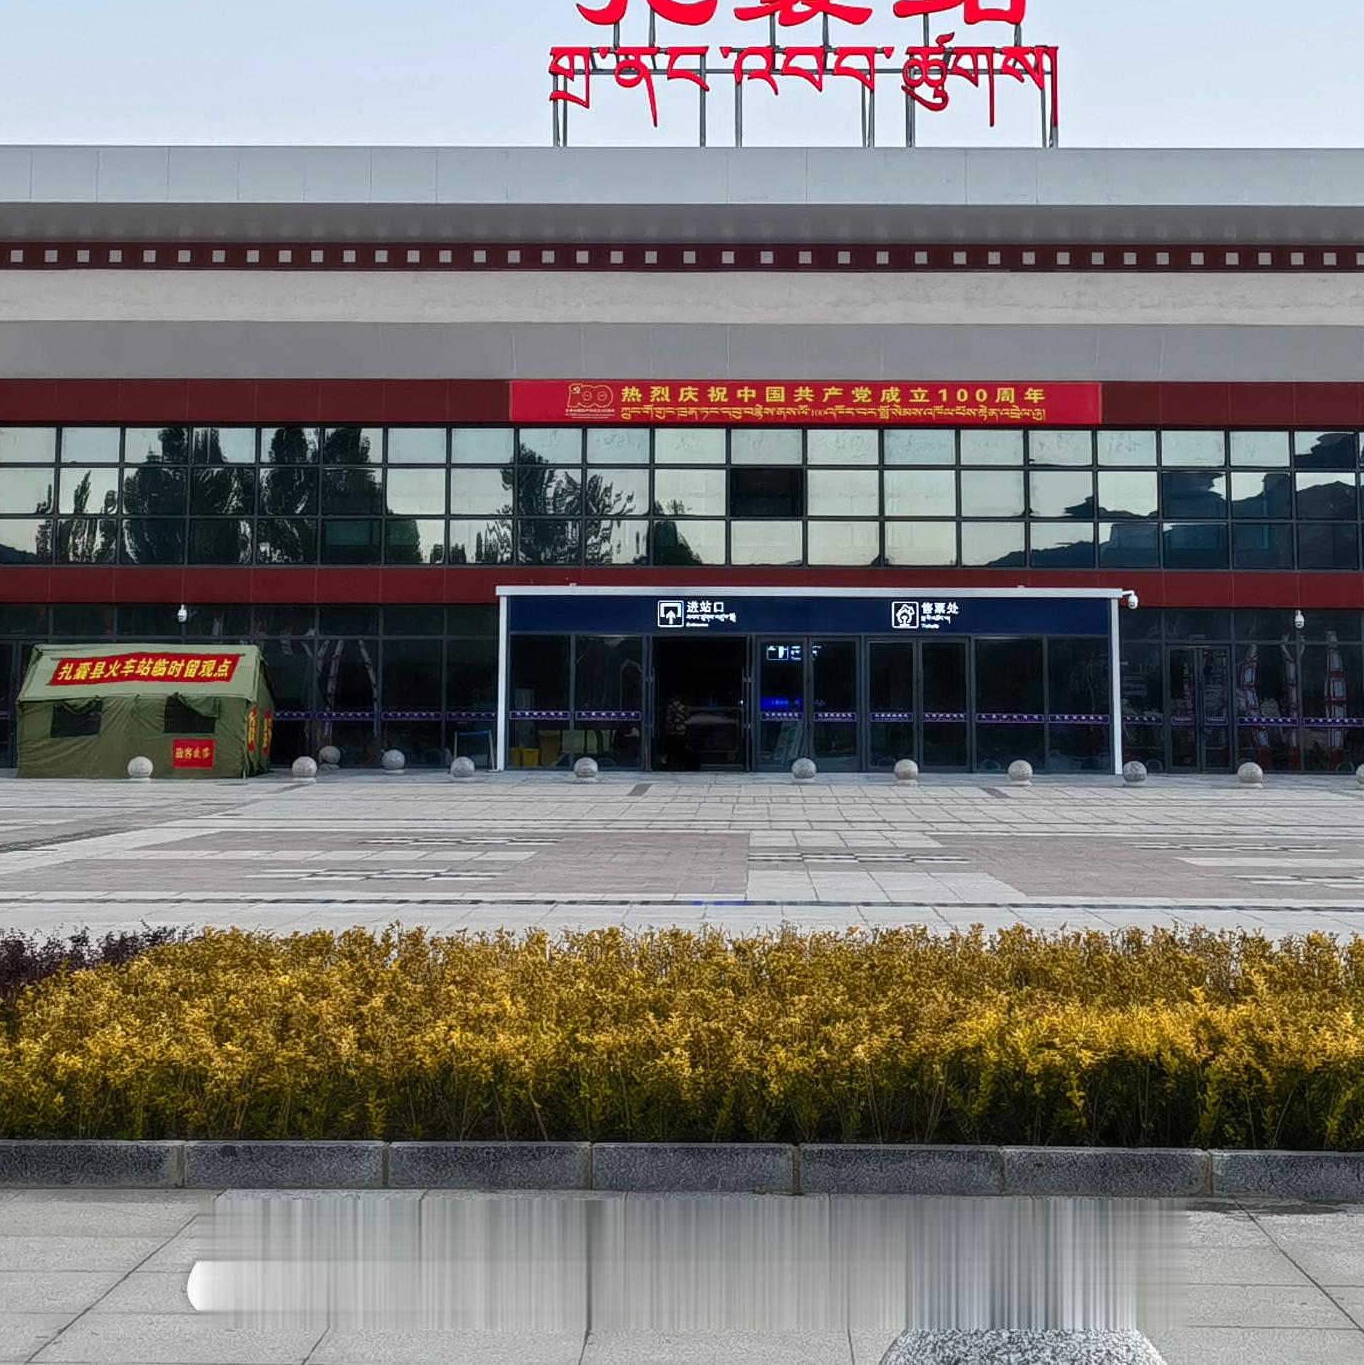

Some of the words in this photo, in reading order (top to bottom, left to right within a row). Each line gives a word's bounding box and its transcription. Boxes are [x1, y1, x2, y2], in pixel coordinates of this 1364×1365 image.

[621, 386, 1046, 403] 热烈庆祝中国共产党成立100周年
[686, 600, 724, 613] 进站口
[921, 602, 959, 615] 售票处
[57, 657, 233, 681] 扎囊县火车站临时留观点
